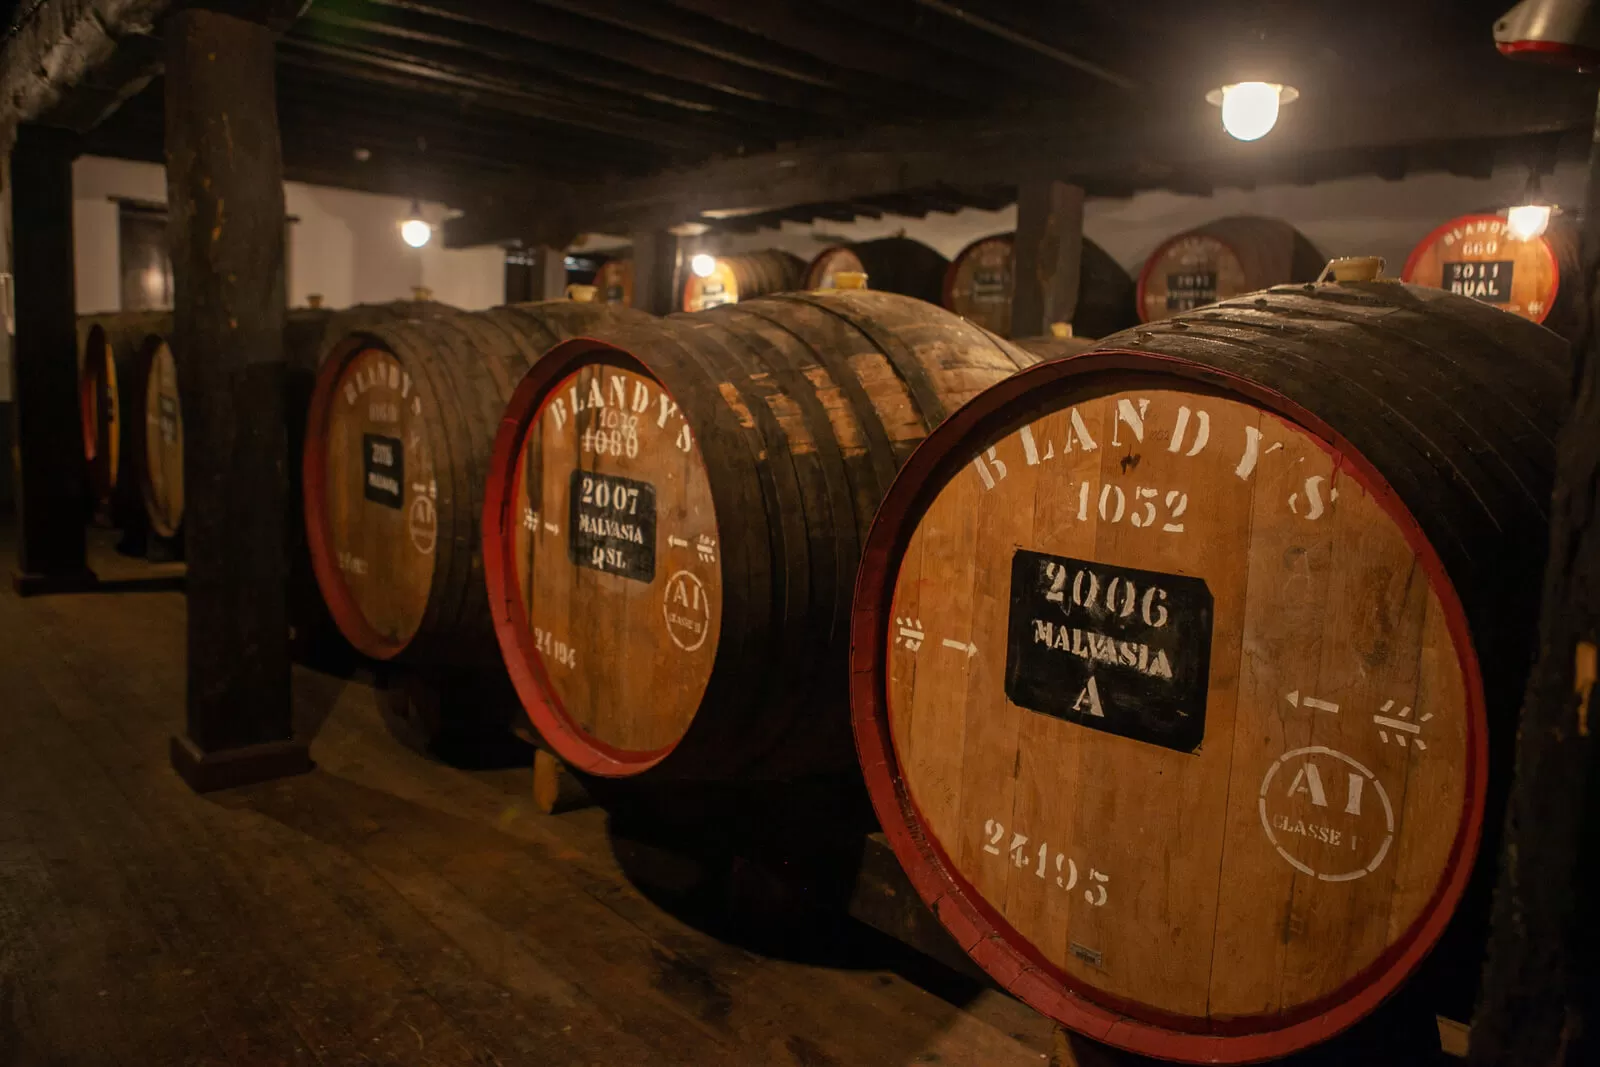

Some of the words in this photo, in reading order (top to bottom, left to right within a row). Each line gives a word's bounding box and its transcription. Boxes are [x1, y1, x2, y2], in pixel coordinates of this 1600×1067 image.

[1444, 220, 1513, 247] BLANDY
[1453, 263, 1499, 279] 2011
[551, 375, 696, 453] BLANDY'S
[974, 399, 1339, 520] BLANDY'S
[582, 477, 639, 515] 2007
[1076, 481, 1188, 532] 1052
[579, 514, 643, 545] MALVASIA
[1045, 561, 1168, 628] 2006
[1032, 619, 1173, 679] MALVASIA
[1072, 676, 1105, 717] A
[1273, 814, 1341, 846] CLASSE
